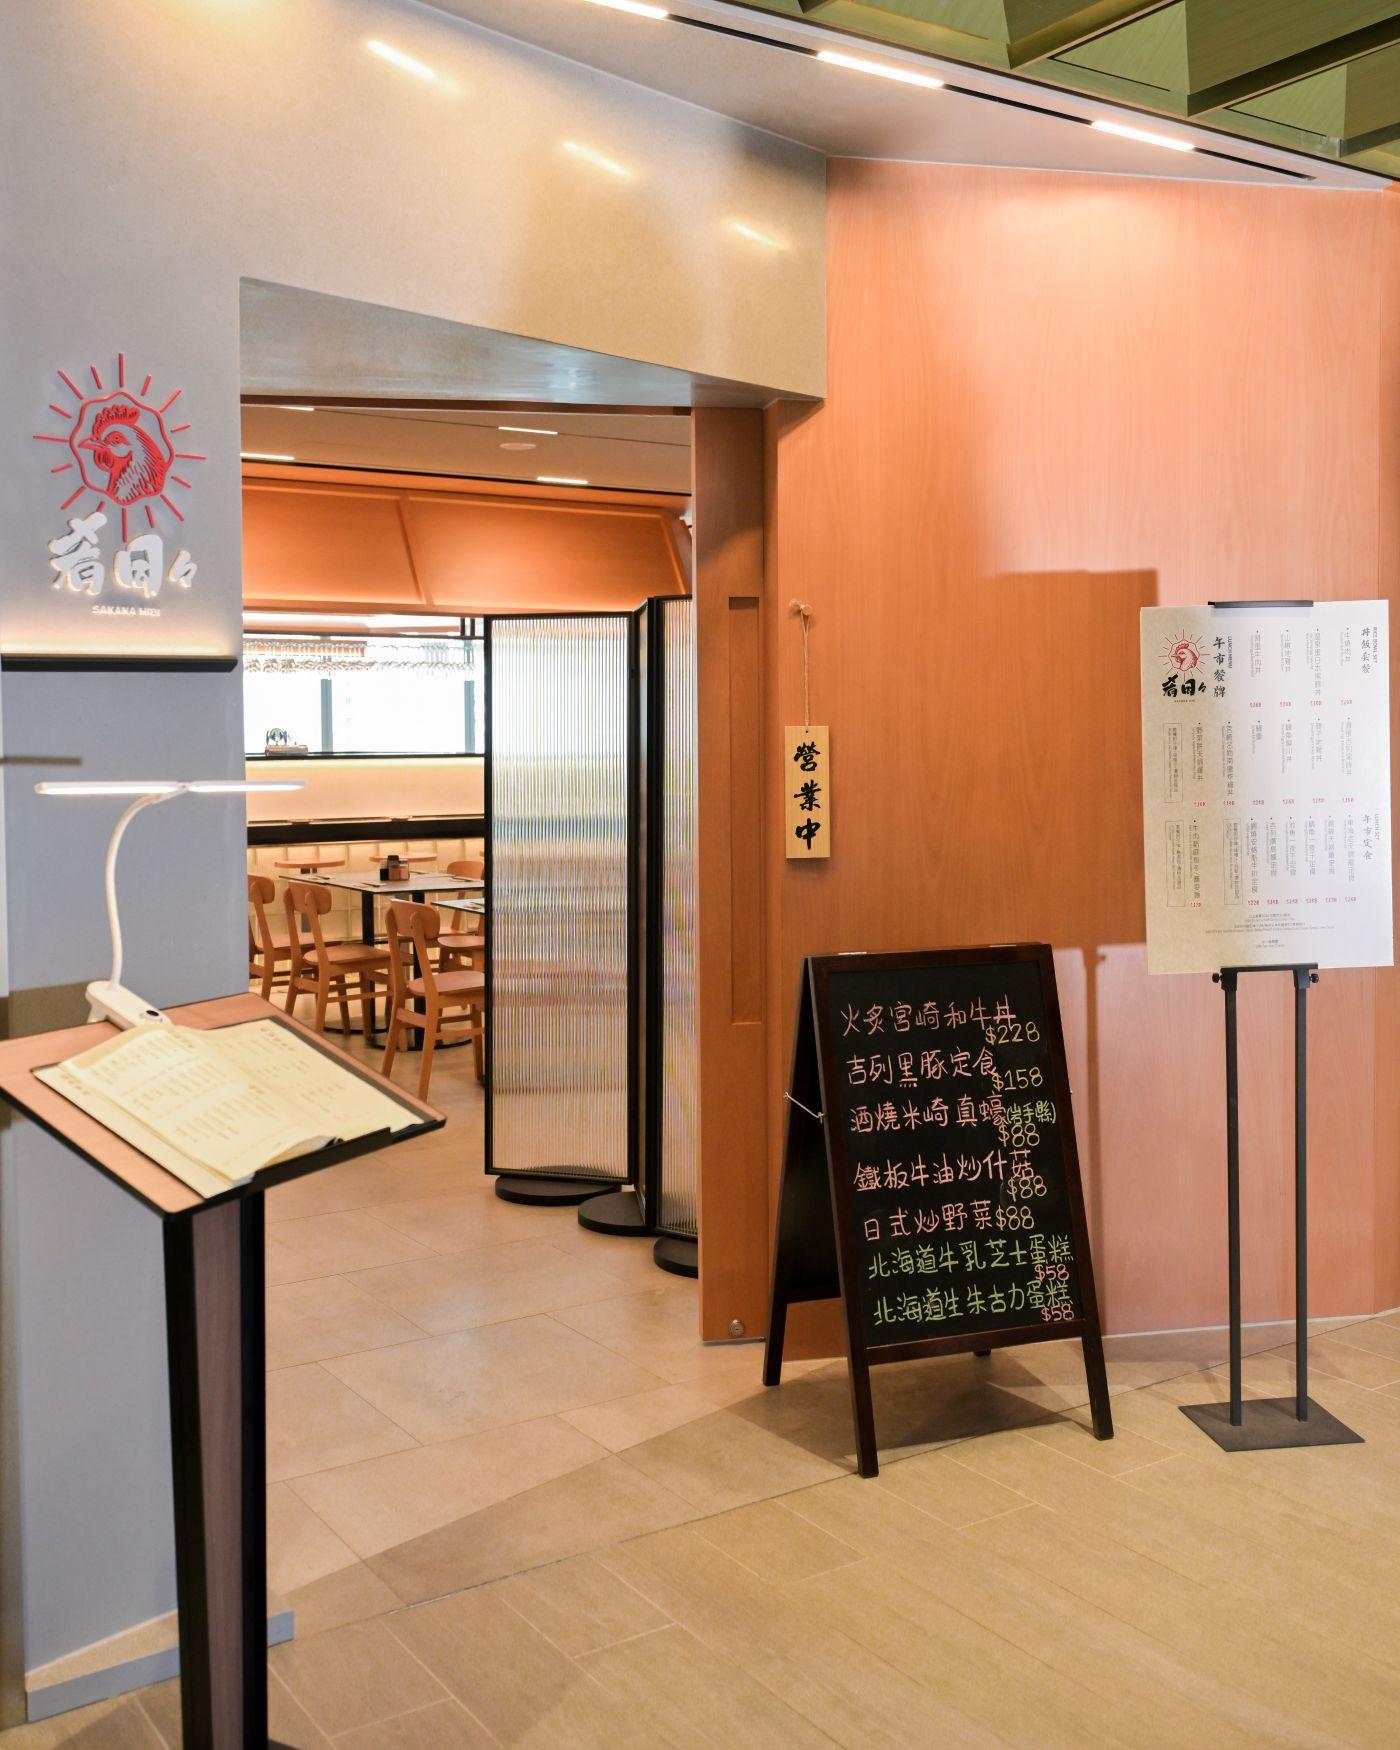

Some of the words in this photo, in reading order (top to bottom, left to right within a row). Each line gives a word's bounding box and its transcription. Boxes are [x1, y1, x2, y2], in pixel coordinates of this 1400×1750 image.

[91, 604, 136, 616] SAKANA
[1213, 636, 1226, 698] 午市餐牌
[793, 741, 822, 851] 營業中
[840, 994, 1017, 1037] 火炙宮崎和牛丼
[985, 1021, 1041, 1045] $228
[992, 1066, 1043, 1091] $158
[998, 1123, 1040, 1147] $88
[853, 1149, 1035, 1192] 鐵板牛油炒什菇
[1007, 1175, 1047, 1202] $88
[864, 1199, 993, 1241] 日式炒野菜
[995, 1205, 1034, 1231] $88
[868, 1233, 1074, 1280] 北海道牛乳芝士蛋糕
[1034, 1263, 1070, 1281] $58
[873, 1279, 1074, 1326] 北海道生朱古力蛋糕
[1041, 1303, 1075, 1322] $58
